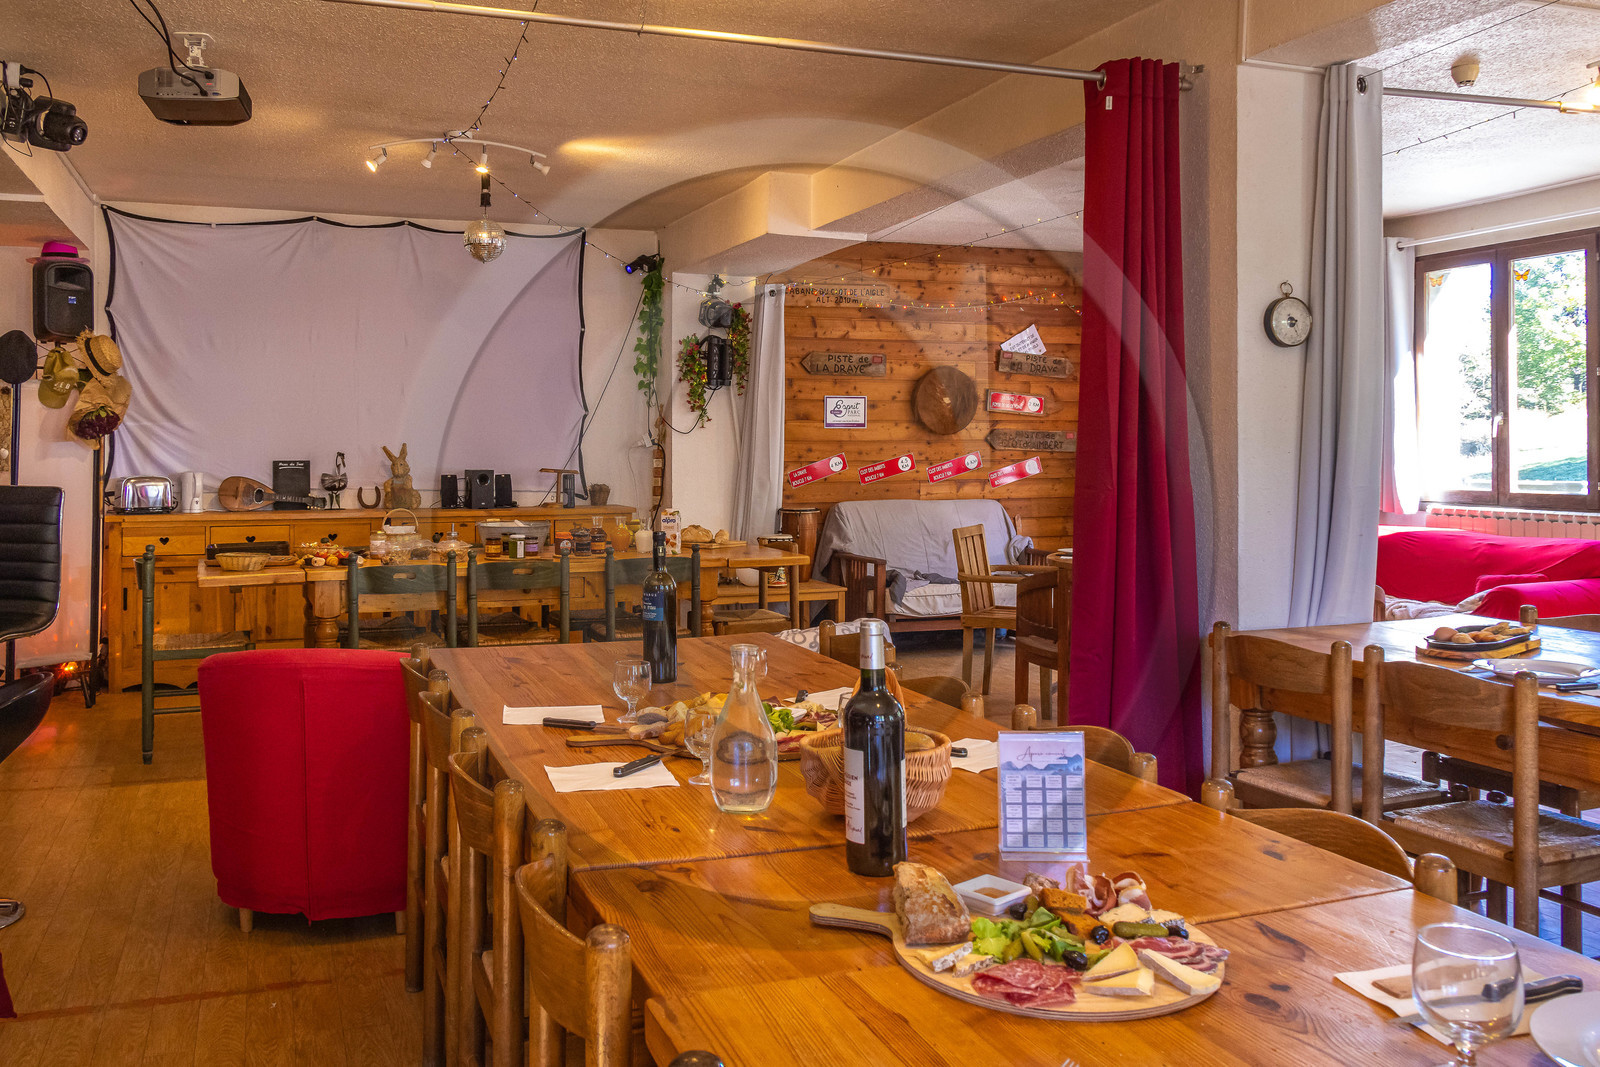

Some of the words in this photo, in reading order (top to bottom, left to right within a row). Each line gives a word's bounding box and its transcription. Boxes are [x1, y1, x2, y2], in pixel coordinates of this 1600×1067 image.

[850, 288, 857, 296] DE
[860, 288, 884, 296] L'AIGLE
[827, 354, 853, 363] PISTE
[858, 355, 869, 363] de
[1026, 354, 1047, 364] PISTE
[816, 364, 829, 373] LA
